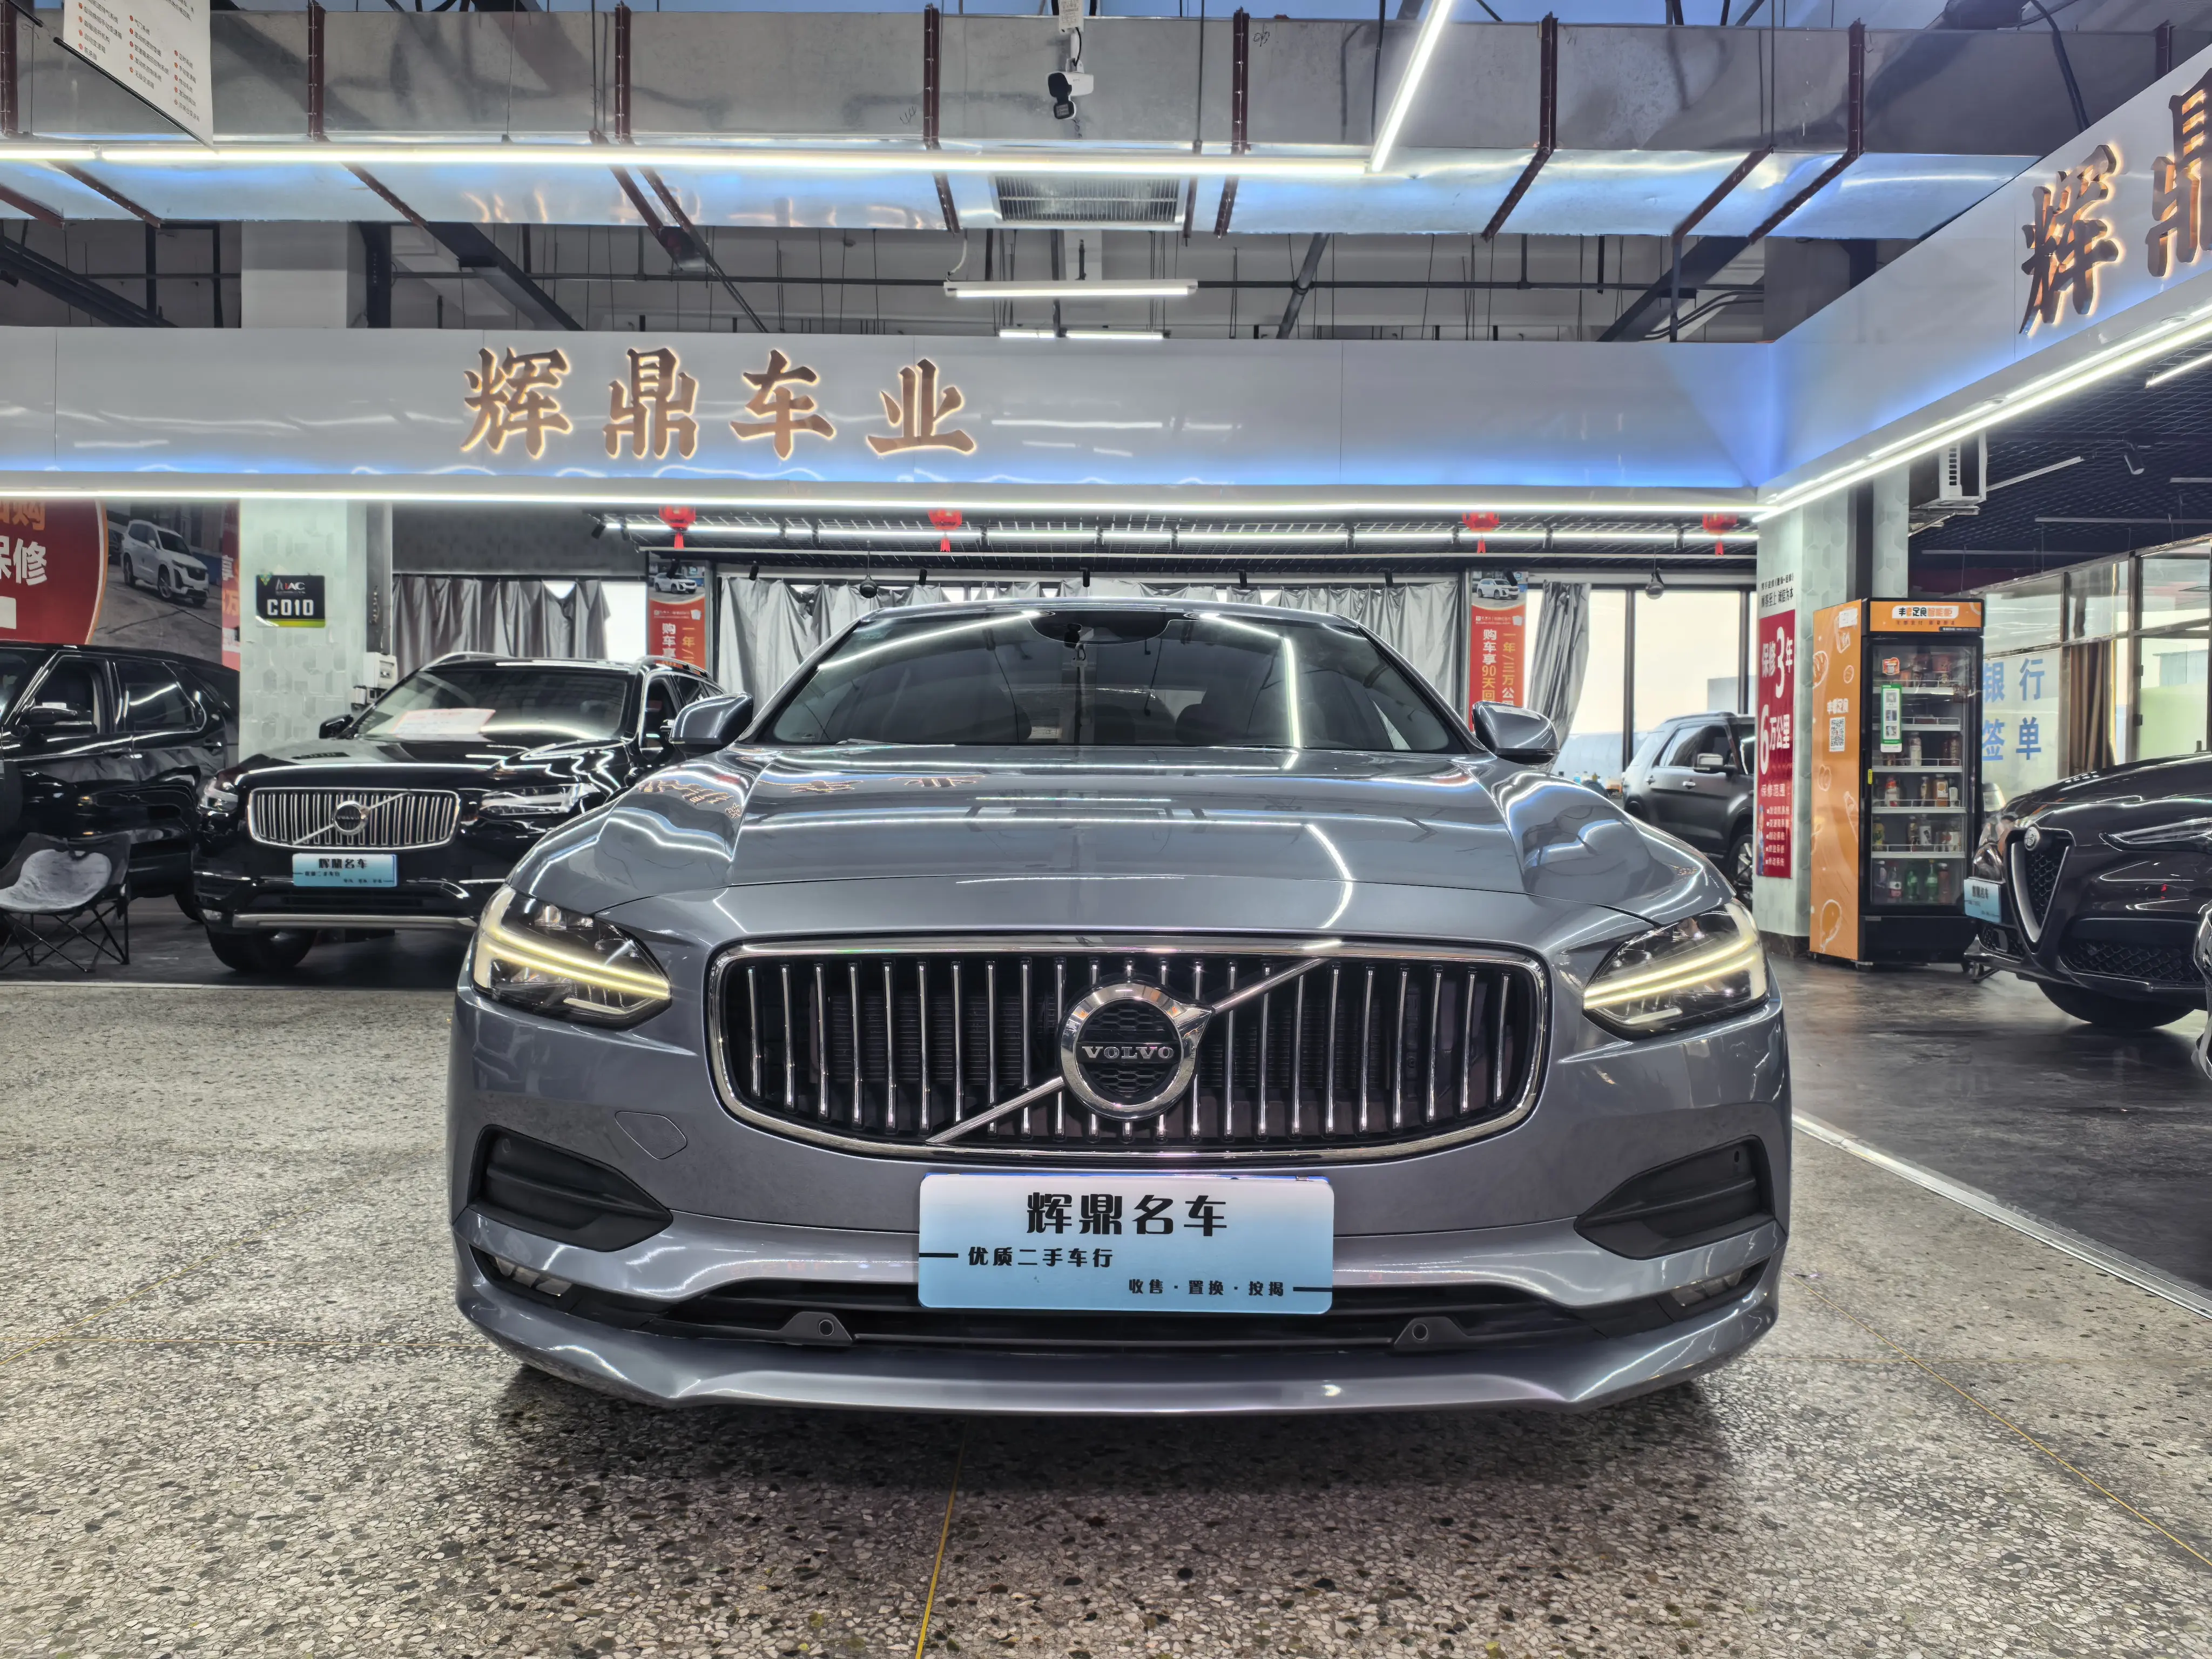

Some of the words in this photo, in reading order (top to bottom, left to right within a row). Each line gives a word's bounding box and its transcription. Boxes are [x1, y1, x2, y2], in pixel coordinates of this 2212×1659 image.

[461, 346, 976, 459] 辉鼎车业
[0, 499, 45, 531] 购
[1983, 658, 2045, 702] 银行
[1982, 717, 2041, 760] 签单
[1082, 1046, 1174, 1059] VOLVO
[1027, 1192, 1228, 1237] 辉鼎名车
[968, 1247, 1113, 1268] 优质二手车行
